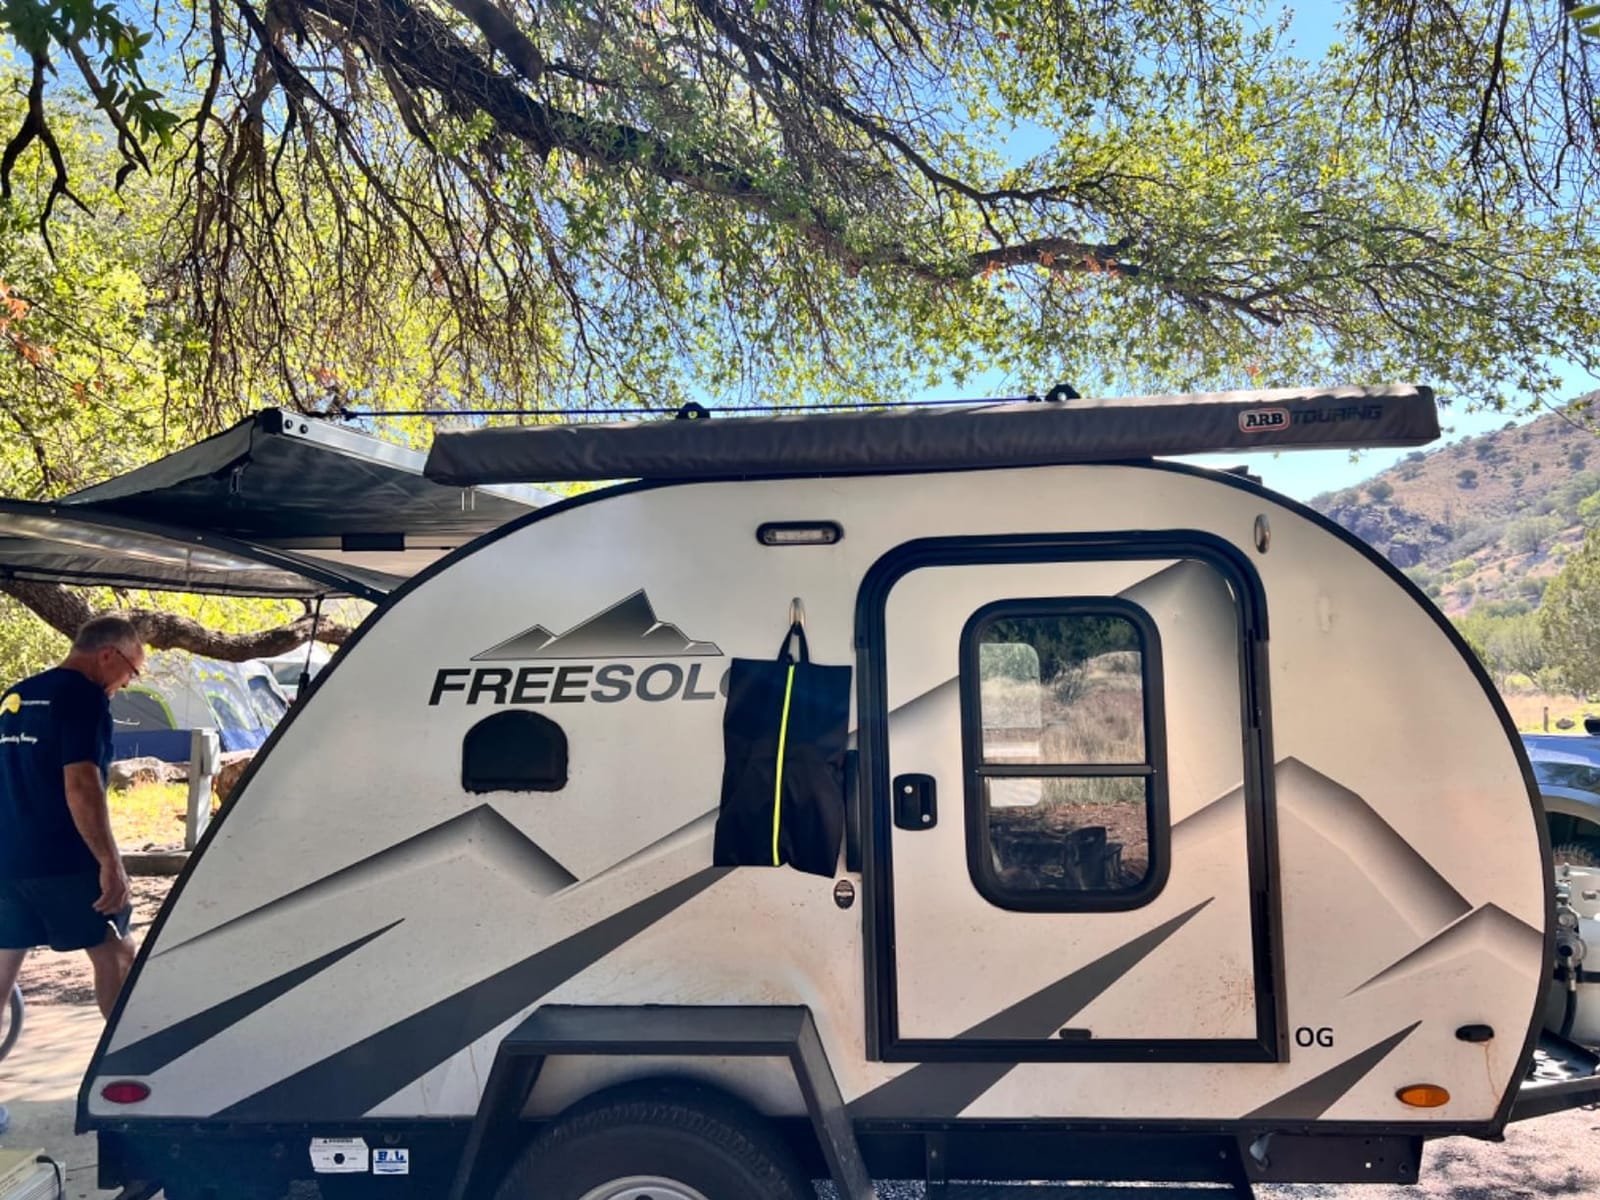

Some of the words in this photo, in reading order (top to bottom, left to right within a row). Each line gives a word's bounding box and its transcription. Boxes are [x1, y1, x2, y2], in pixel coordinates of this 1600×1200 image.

[1246, 413, 1284, 427] ARB
[1292, 404, 1383, 424] TOURING
[428, 663, 732, 706] FREESOL
[1295, 1027, 1334, 1047] OG
